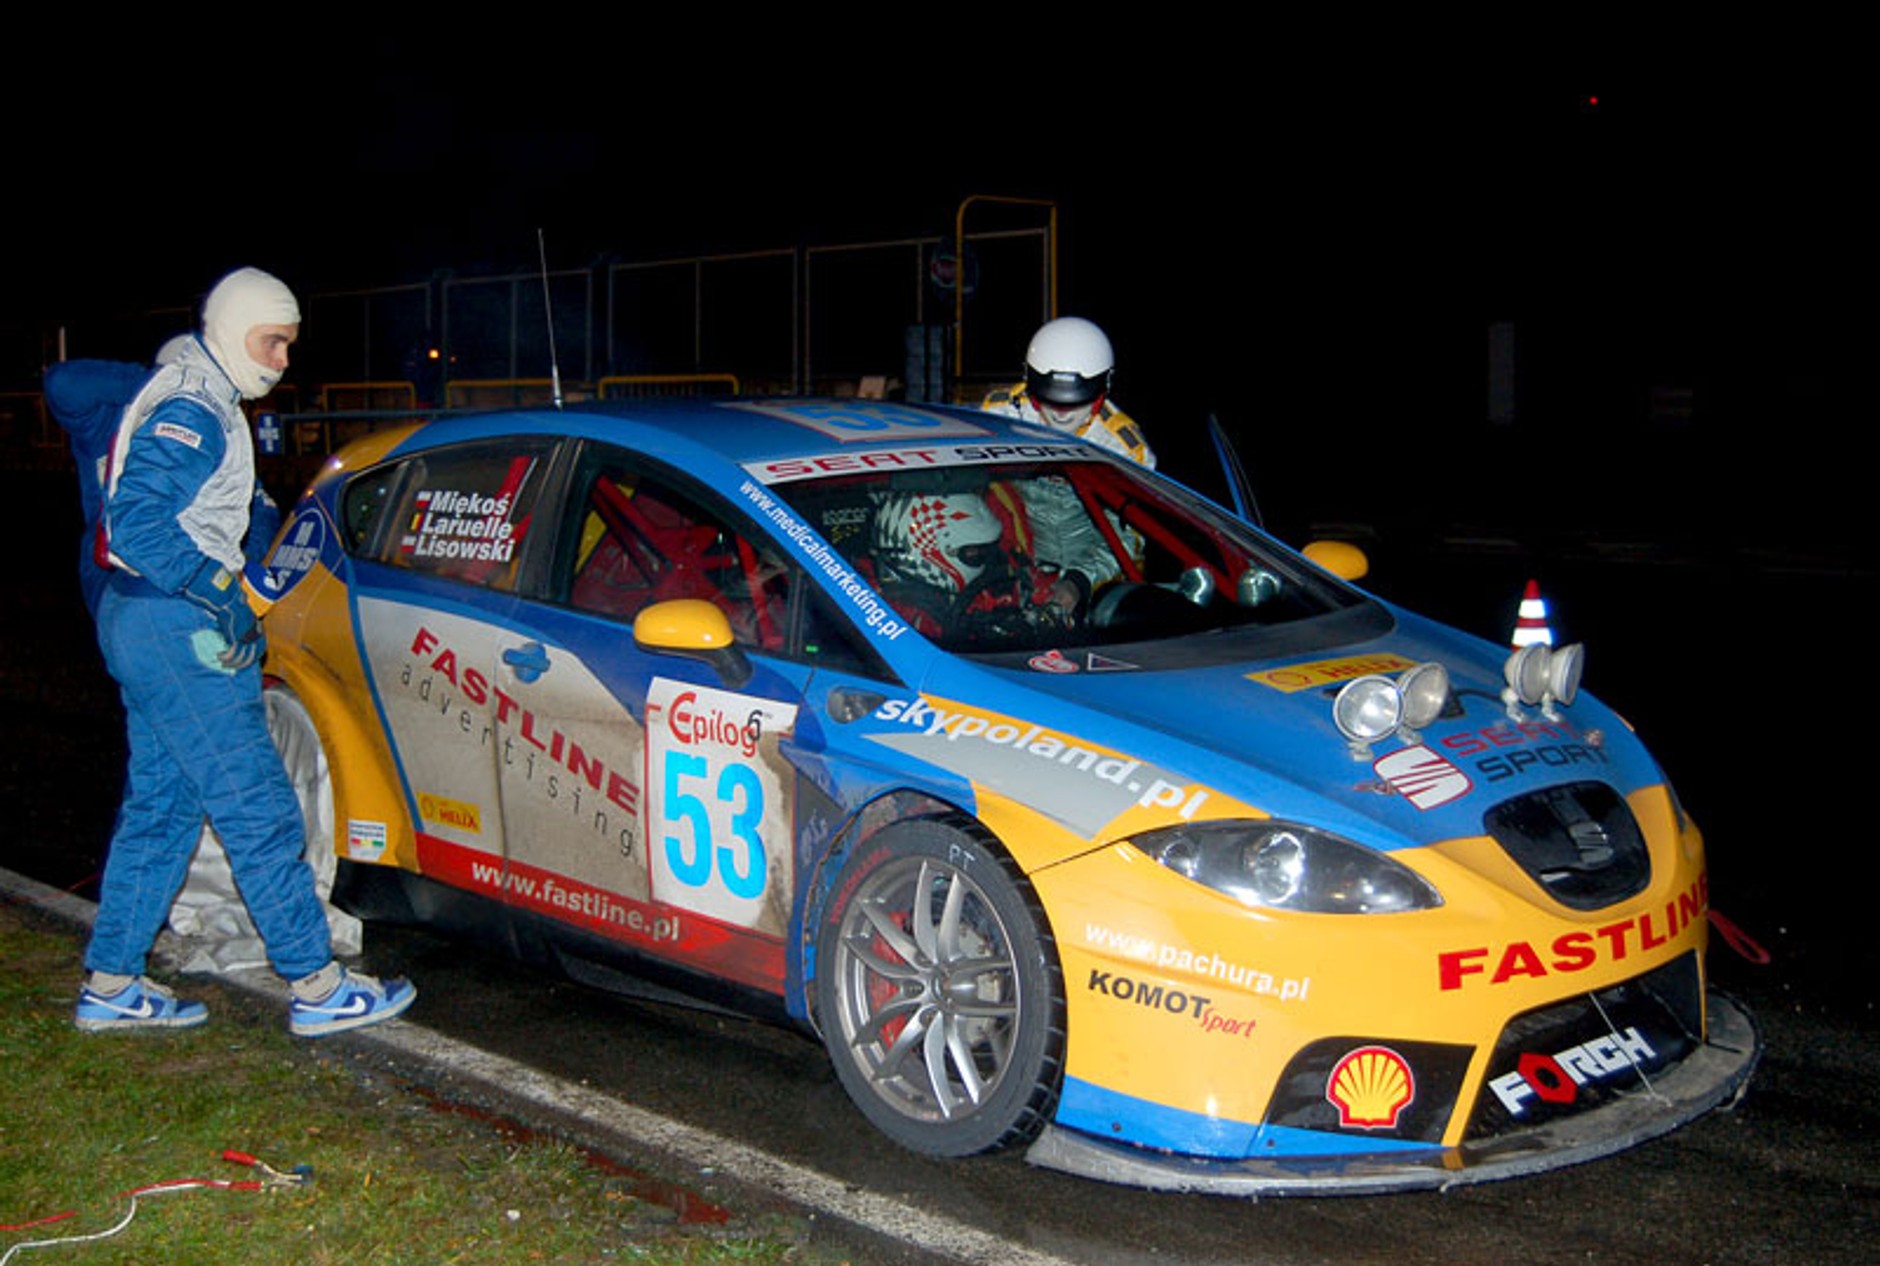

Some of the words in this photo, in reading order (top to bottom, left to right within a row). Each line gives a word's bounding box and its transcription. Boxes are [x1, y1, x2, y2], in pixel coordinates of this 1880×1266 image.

[765, 450, 937, 478] SEAT
[954, 446, 1088, 461] SPORT
[422, 512, 513, 540] Laruelle
[429, 490, 511, 517] Miękoś
[414, 534, 515, 562] Lisowski
[739, 481, 908, 640] www.medicalmarketing.pl
[411, 626, 641, 817] FASTLINE
[668, 691, 757, 758] Epilog
[1440, 721, 1581, 758] SEAT
[400, 664, 634, 857] advertising
[875, 697, 1210, 820] skypoland.pl
[1476, 744, 1609, 782] SPORT
[663, 749, 767, 899] 53
[471, 862, 680, 941] www.fastline.pl
[1085, 923, 1310, 1001] www.pachura.pl
[1088, 969, 1211, 1019] KOMOT
[1488, 1026, 1657, 1116] FORCH
